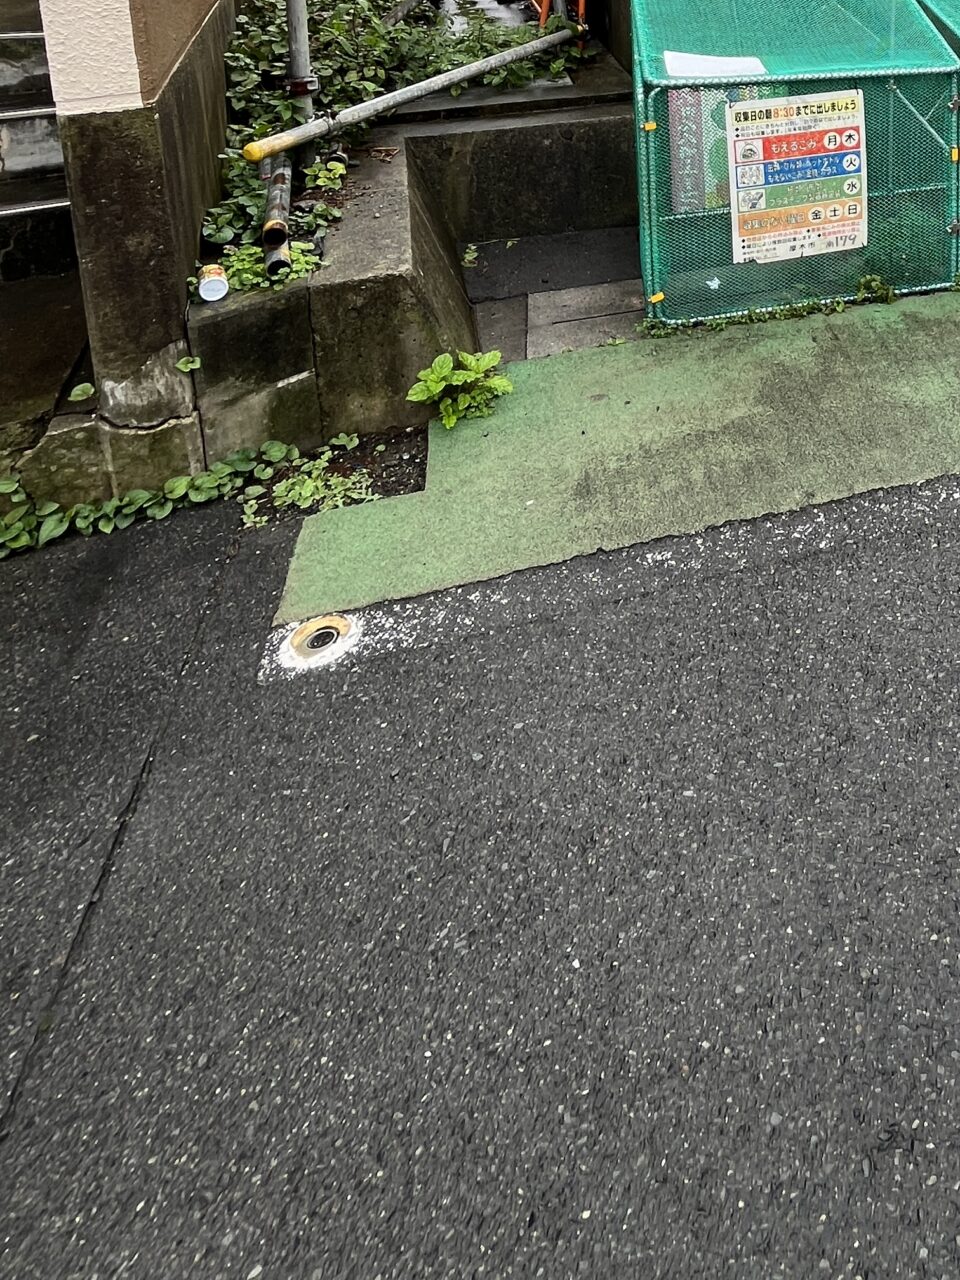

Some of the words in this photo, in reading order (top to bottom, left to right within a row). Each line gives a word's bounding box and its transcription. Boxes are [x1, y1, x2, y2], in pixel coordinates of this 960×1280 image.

[827, 136, 837, 146] 月
[845, 132, 856, 142] 木
[846, 158, 856, 168] 火
[847, 180, 857, 191] 水
[812, 209, 822, 219] 金
[829, 207, 840, 217] 土
[848, 204, 857, 215] 日
